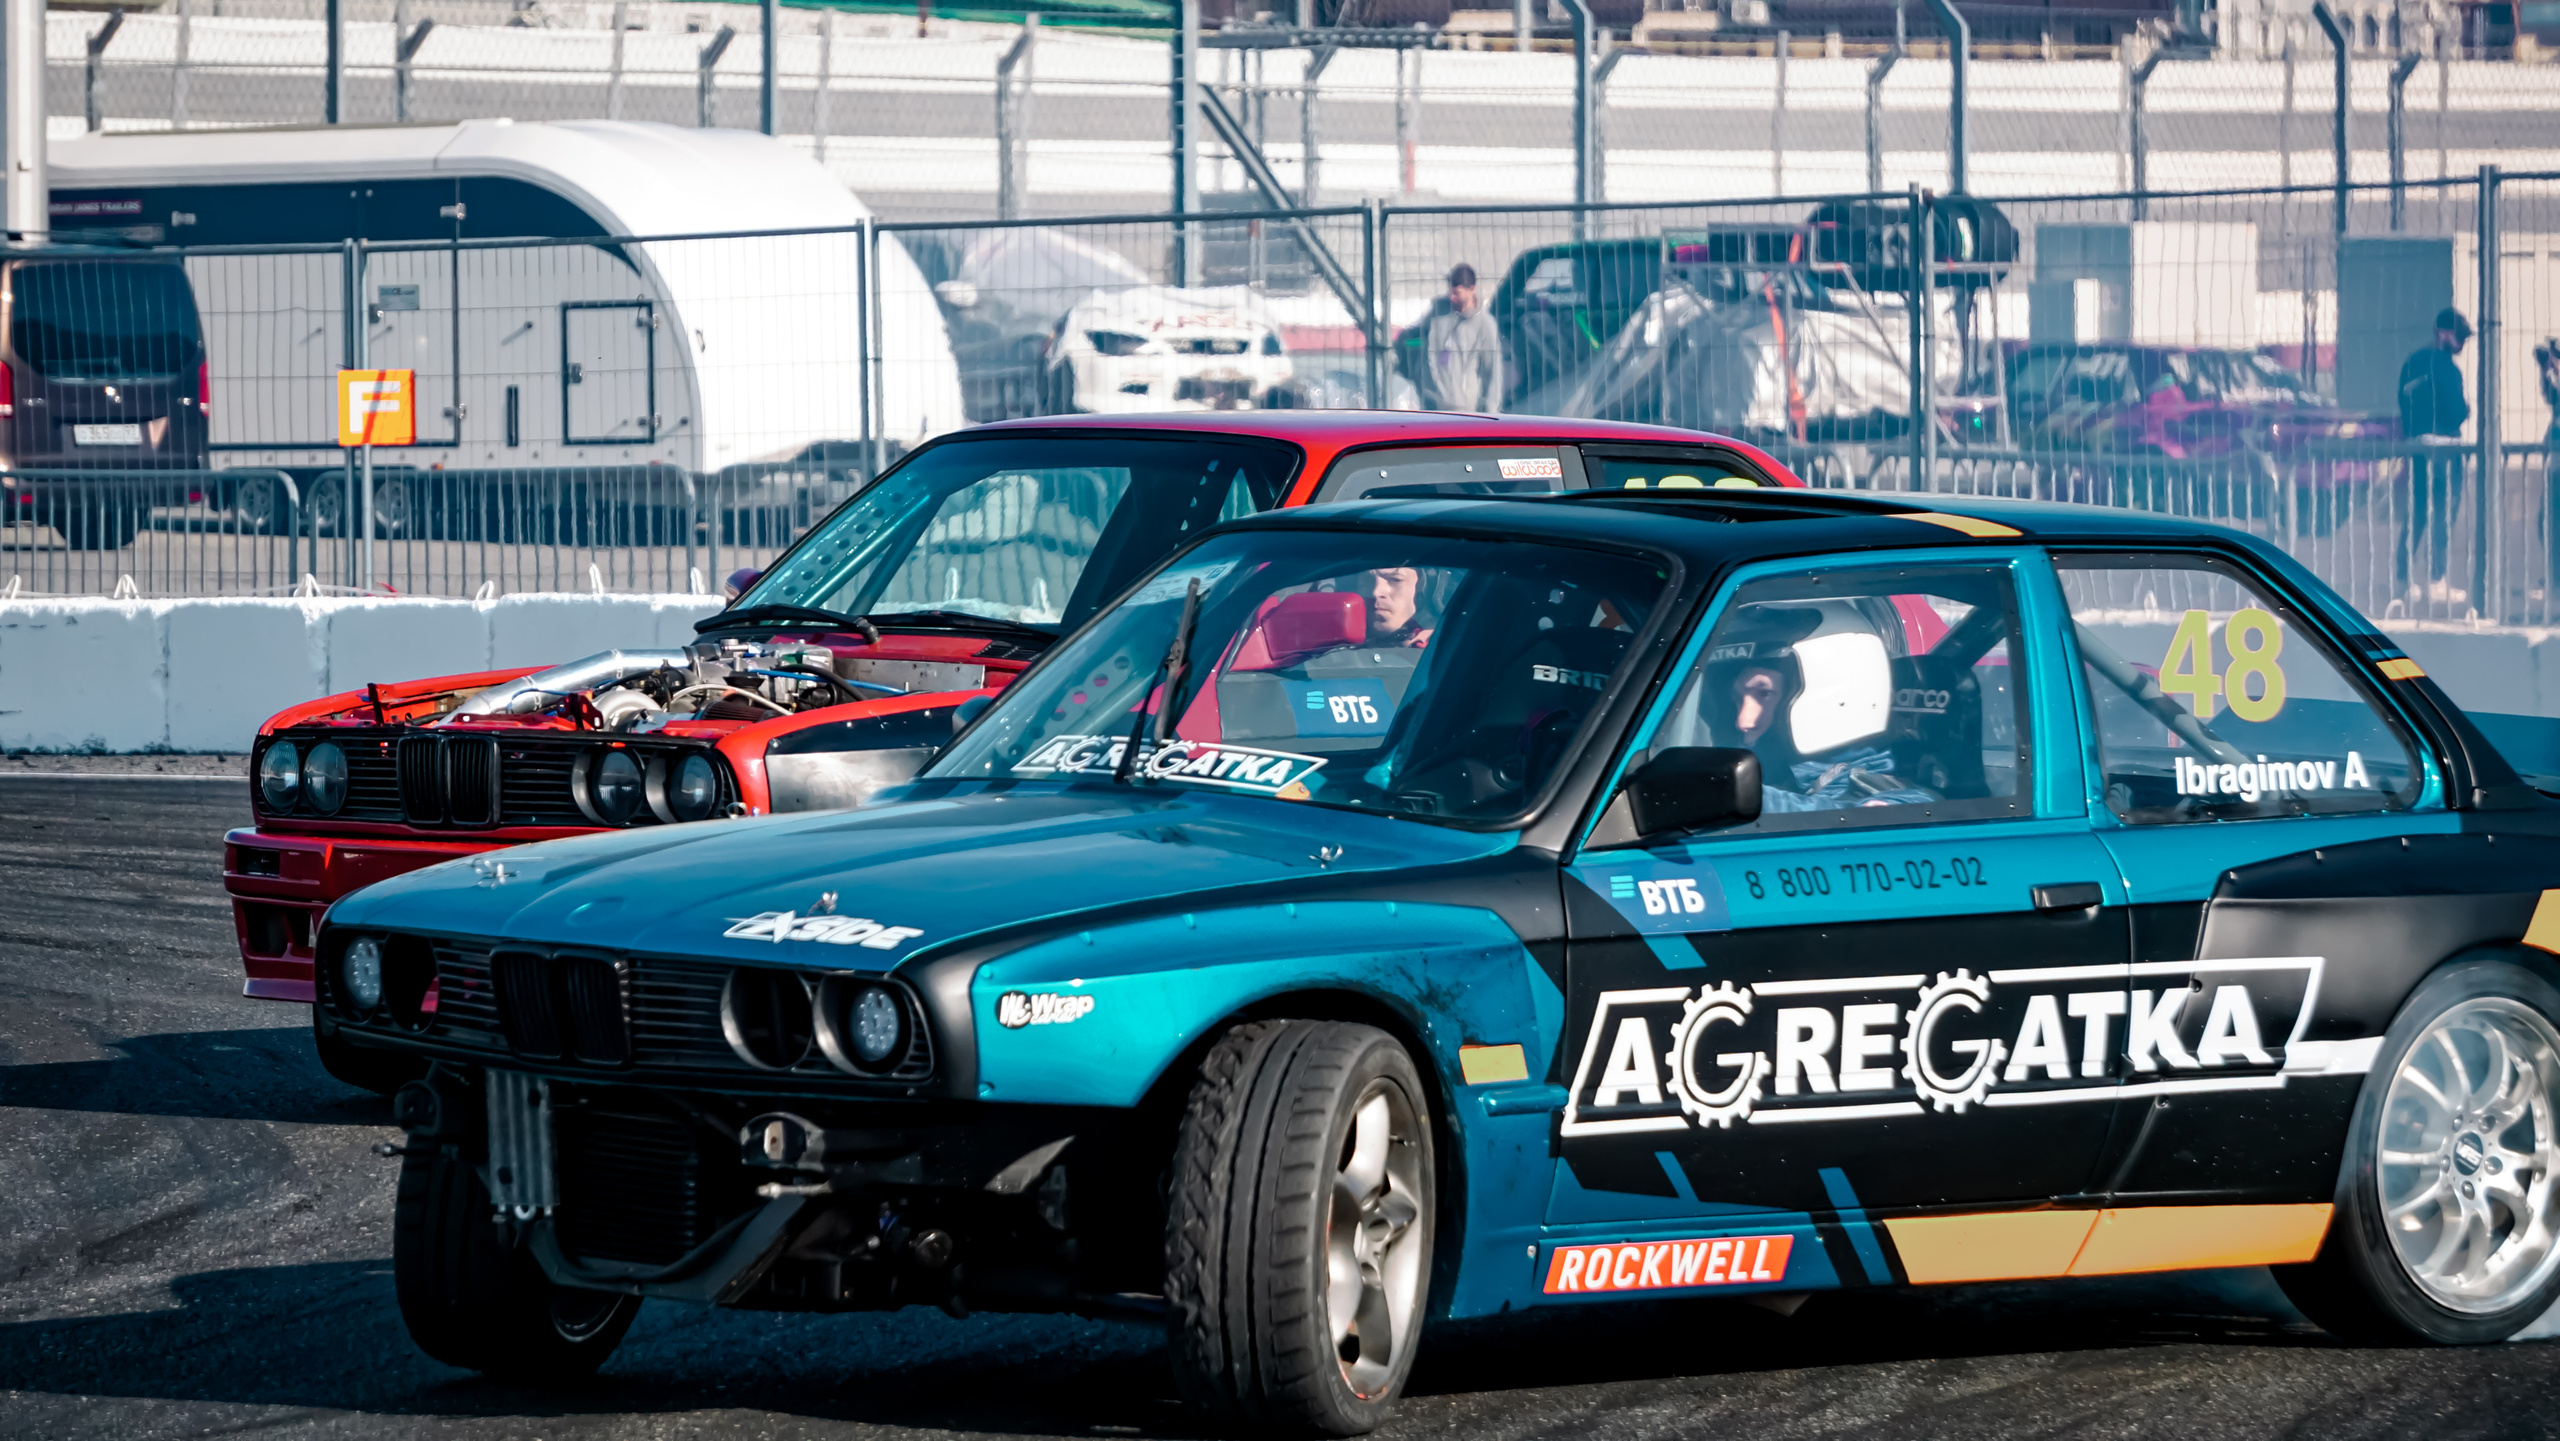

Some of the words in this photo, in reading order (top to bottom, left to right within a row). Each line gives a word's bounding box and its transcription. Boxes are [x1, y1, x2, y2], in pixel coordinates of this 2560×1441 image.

[349, 380, 401, 434] F
[2159, 607, 2287, 723] 48
[1328, 695, 1379, 724] ВТБ
[2175, 754, 2337, 804] Ibragimov
[2344, 751, 2372, 788] A
[1638, 878, 1706, 916] ВТБ
[1744, 871, 1765, 899] 8
[1778, 866, 1831, 898] 800
[1839, 857, 1988, 893] 770-02-02
[1594, 967, 2276, 1129] AGREGATKA
[1557, 1239, 1771, 1291] ROCKWELL
